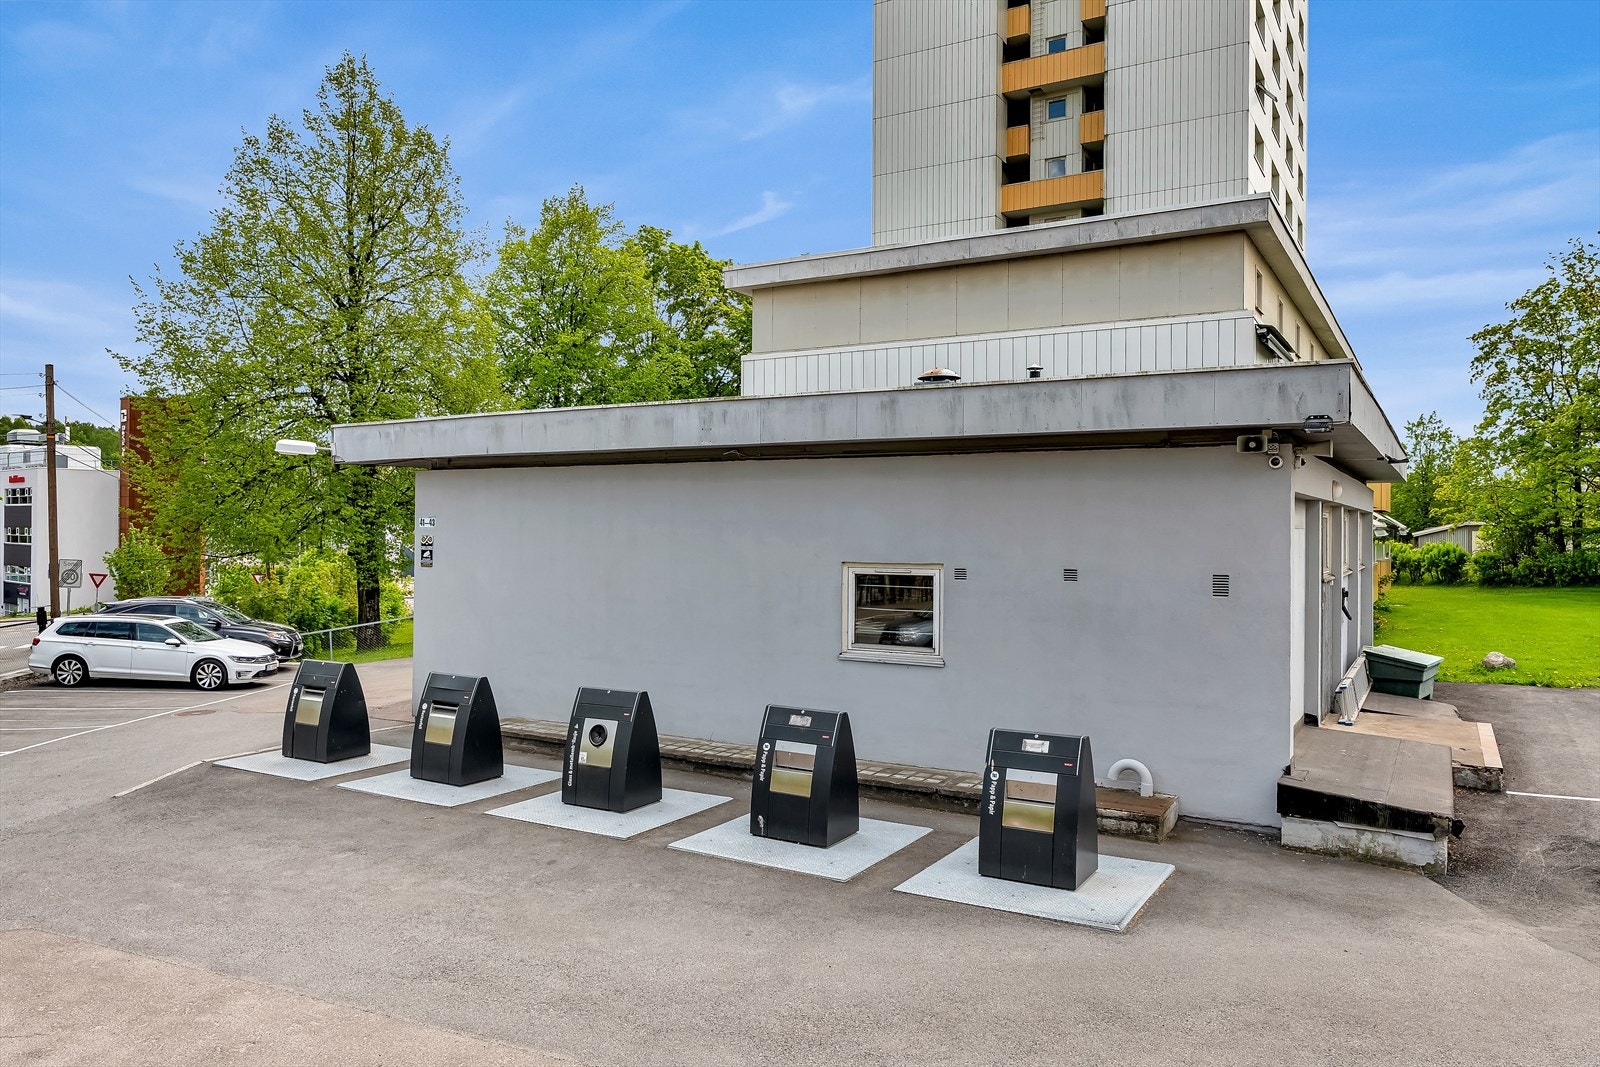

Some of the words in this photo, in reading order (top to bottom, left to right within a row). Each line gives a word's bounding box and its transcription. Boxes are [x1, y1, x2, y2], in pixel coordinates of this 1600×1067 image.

[760, 750, 769, 764] Papp
[759, 769, 767, 782] Papir
[989, 780, 998, 795] Papp
[988, 800, 996, 816] Papir
